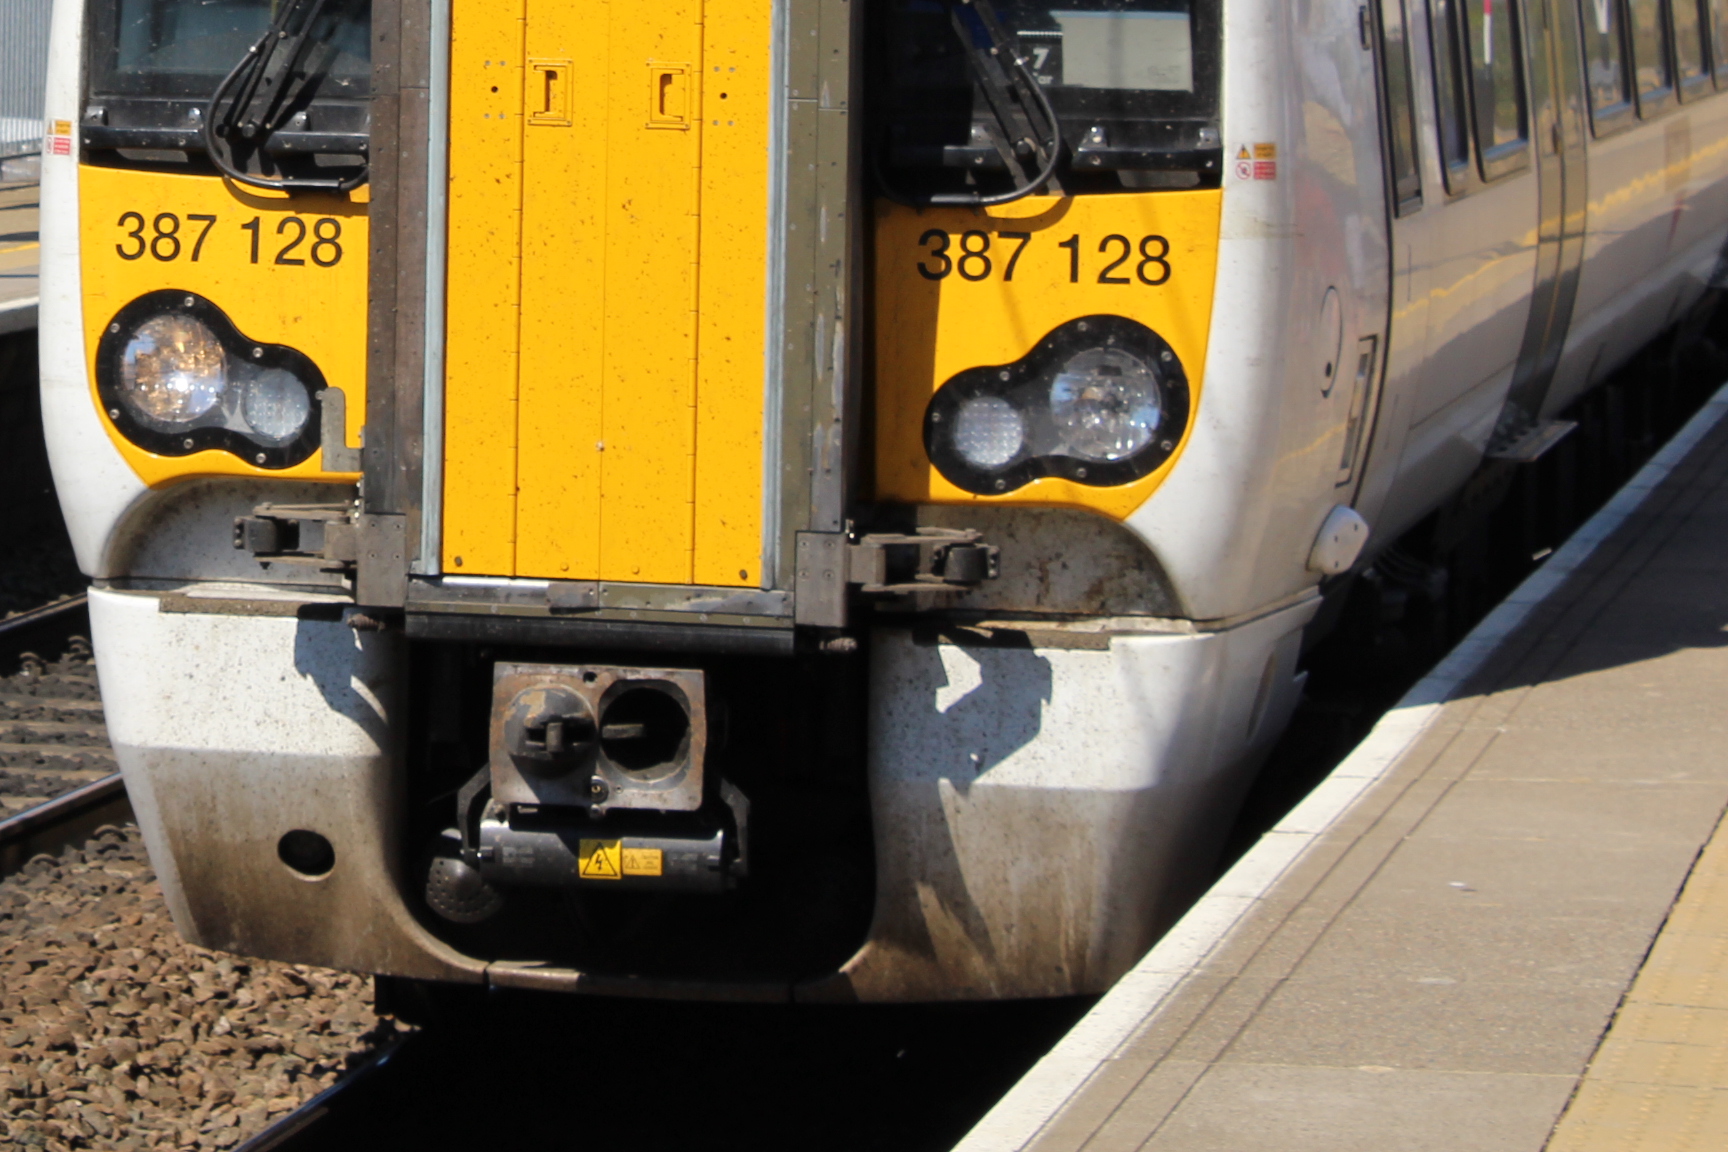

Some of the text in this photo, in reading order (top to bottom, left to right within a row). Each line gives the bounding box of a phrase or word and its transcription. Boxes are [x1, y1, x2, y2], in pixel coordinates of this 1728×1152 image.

[1032, 47, 1050, 70] 7
[1032, 72, 1054, 85] ar
[115, 211, 343, 268] 387 128
[916, 228, 1172, 286] 387 128
